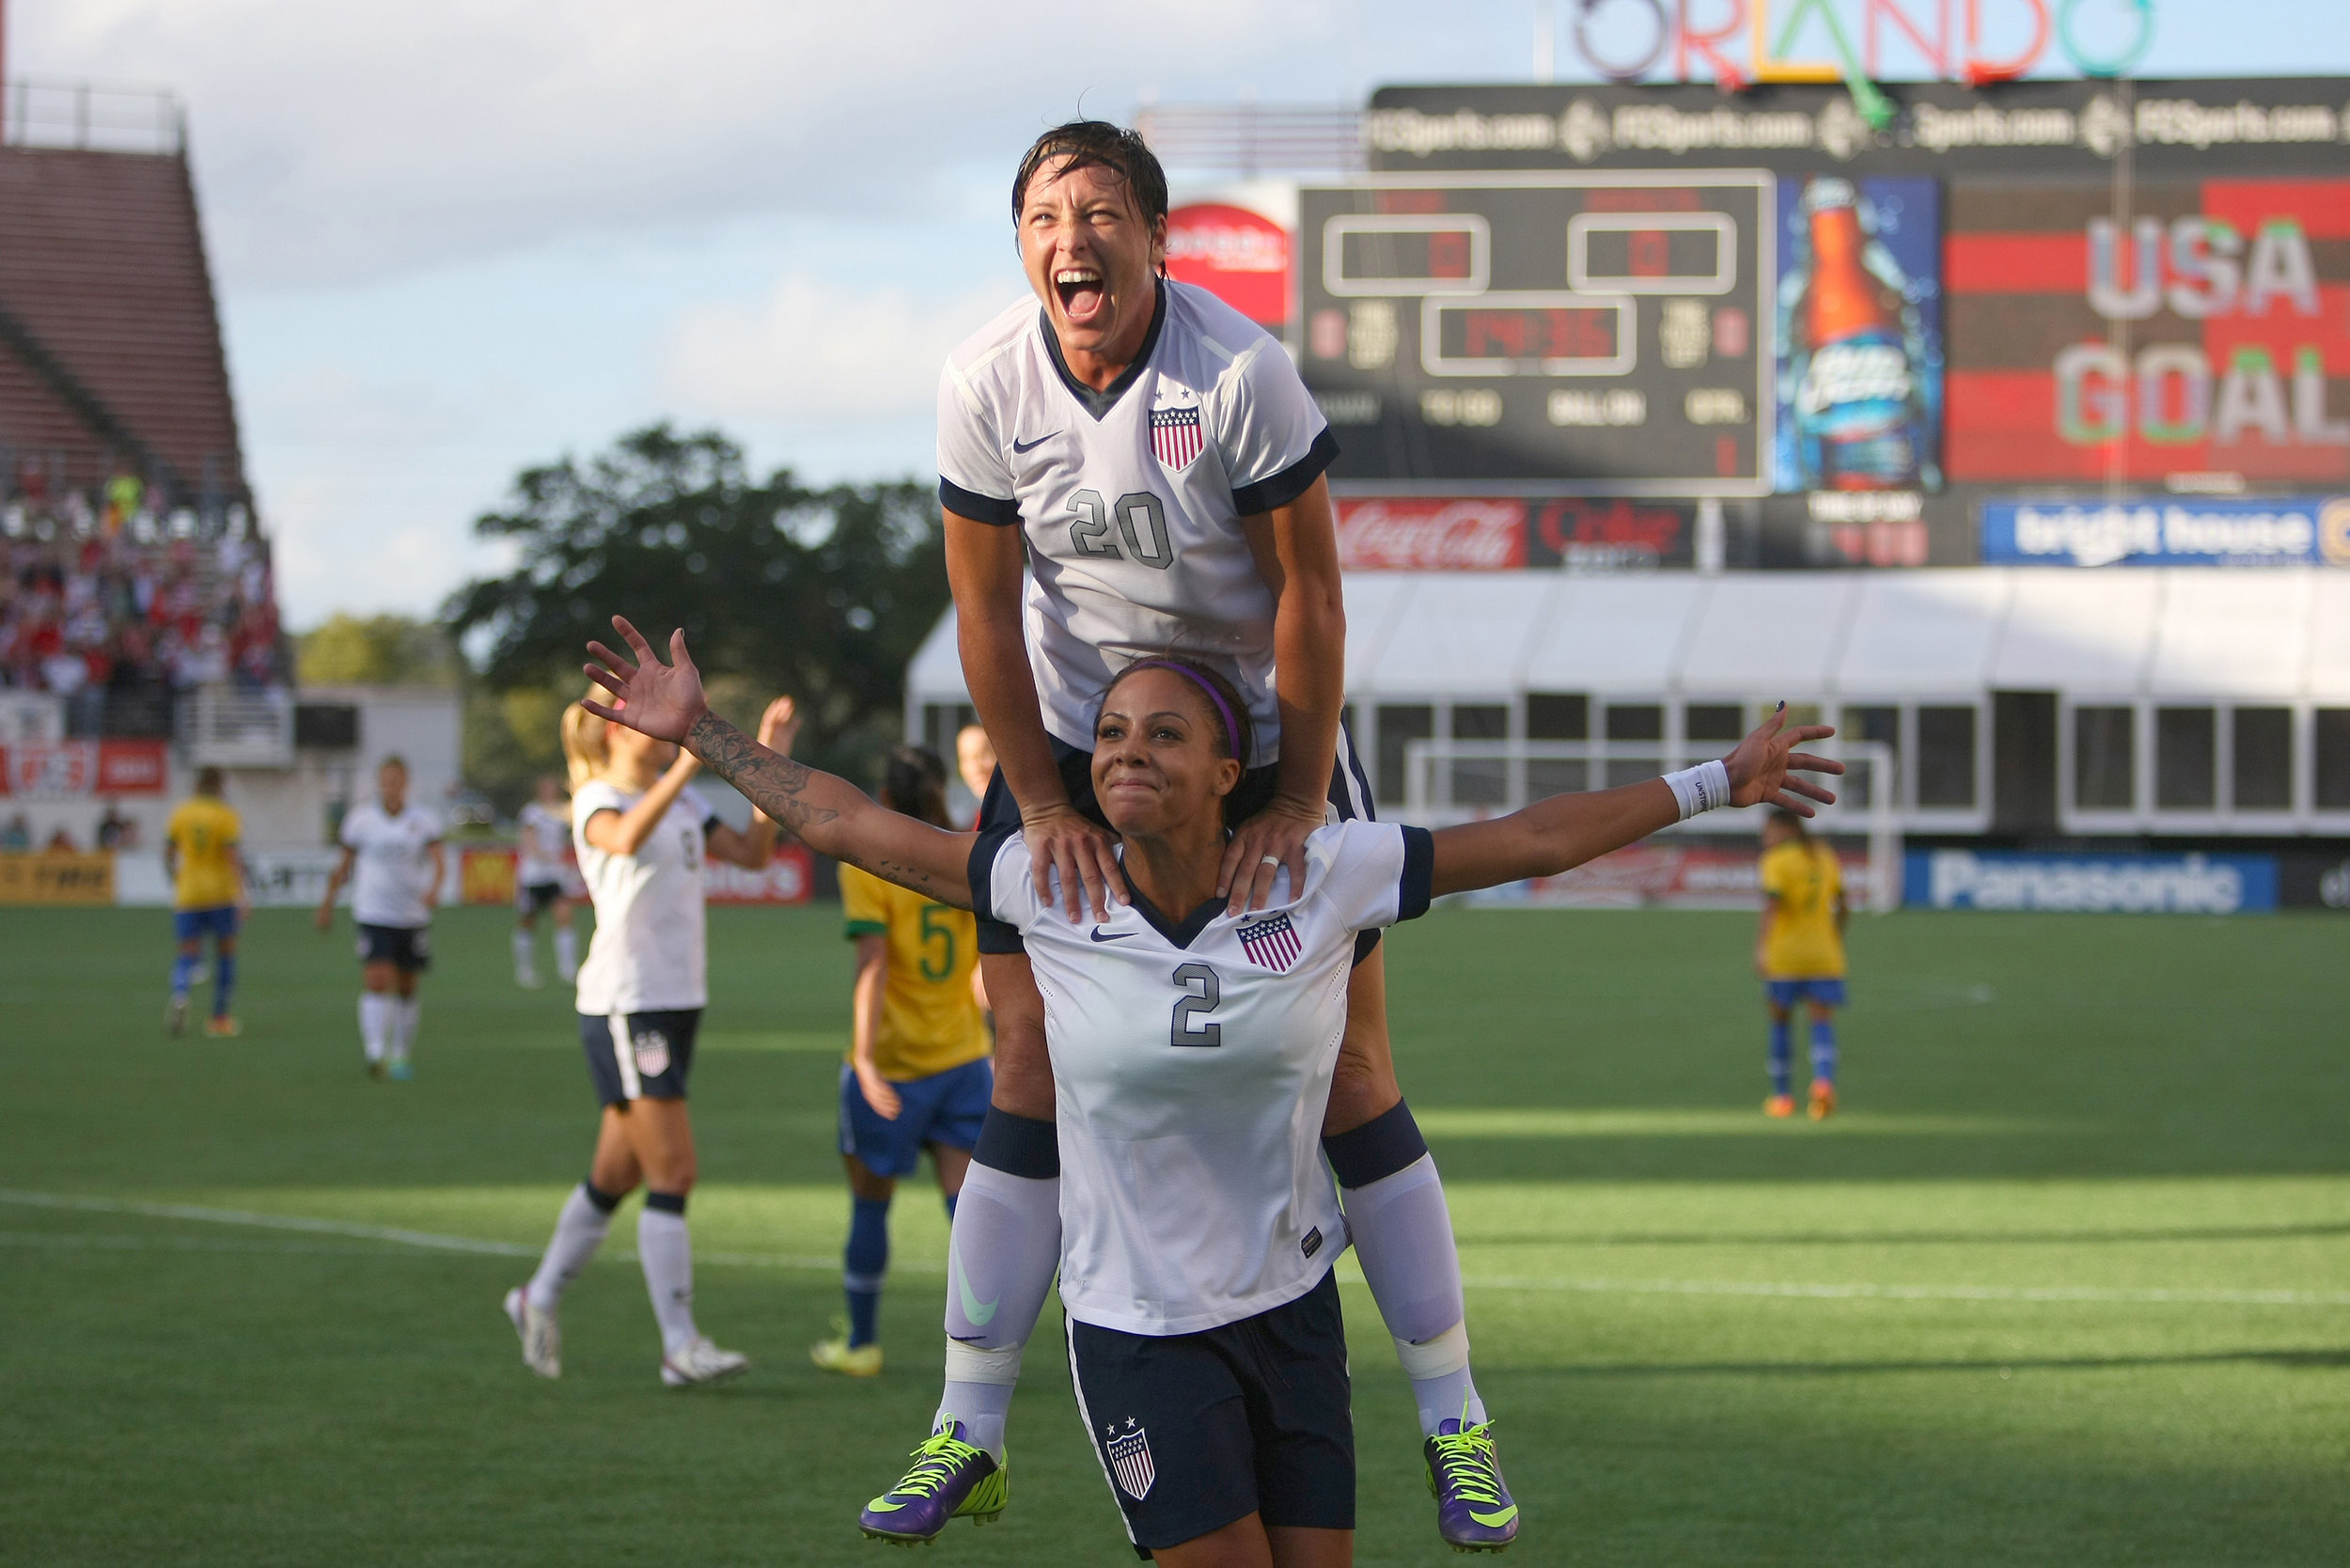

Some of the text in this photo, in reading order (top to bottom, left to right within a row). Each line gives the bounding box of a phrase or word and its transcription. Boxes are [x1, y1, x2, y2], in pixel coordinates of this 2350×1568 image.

[1572, 0, 2154, 130] ORLANDO
[2087, 217, 2320, 318] USA
[2055, 343, 2350, 445] GOAL
[1066, 488, 1174, 570] 20
[2015, 505, 2312, 566] bright house
[1931, 848, 2243, 914] Panasonic
[919, 903, 955, 983] 5
[1170, 963, 1221, 1046] 2
